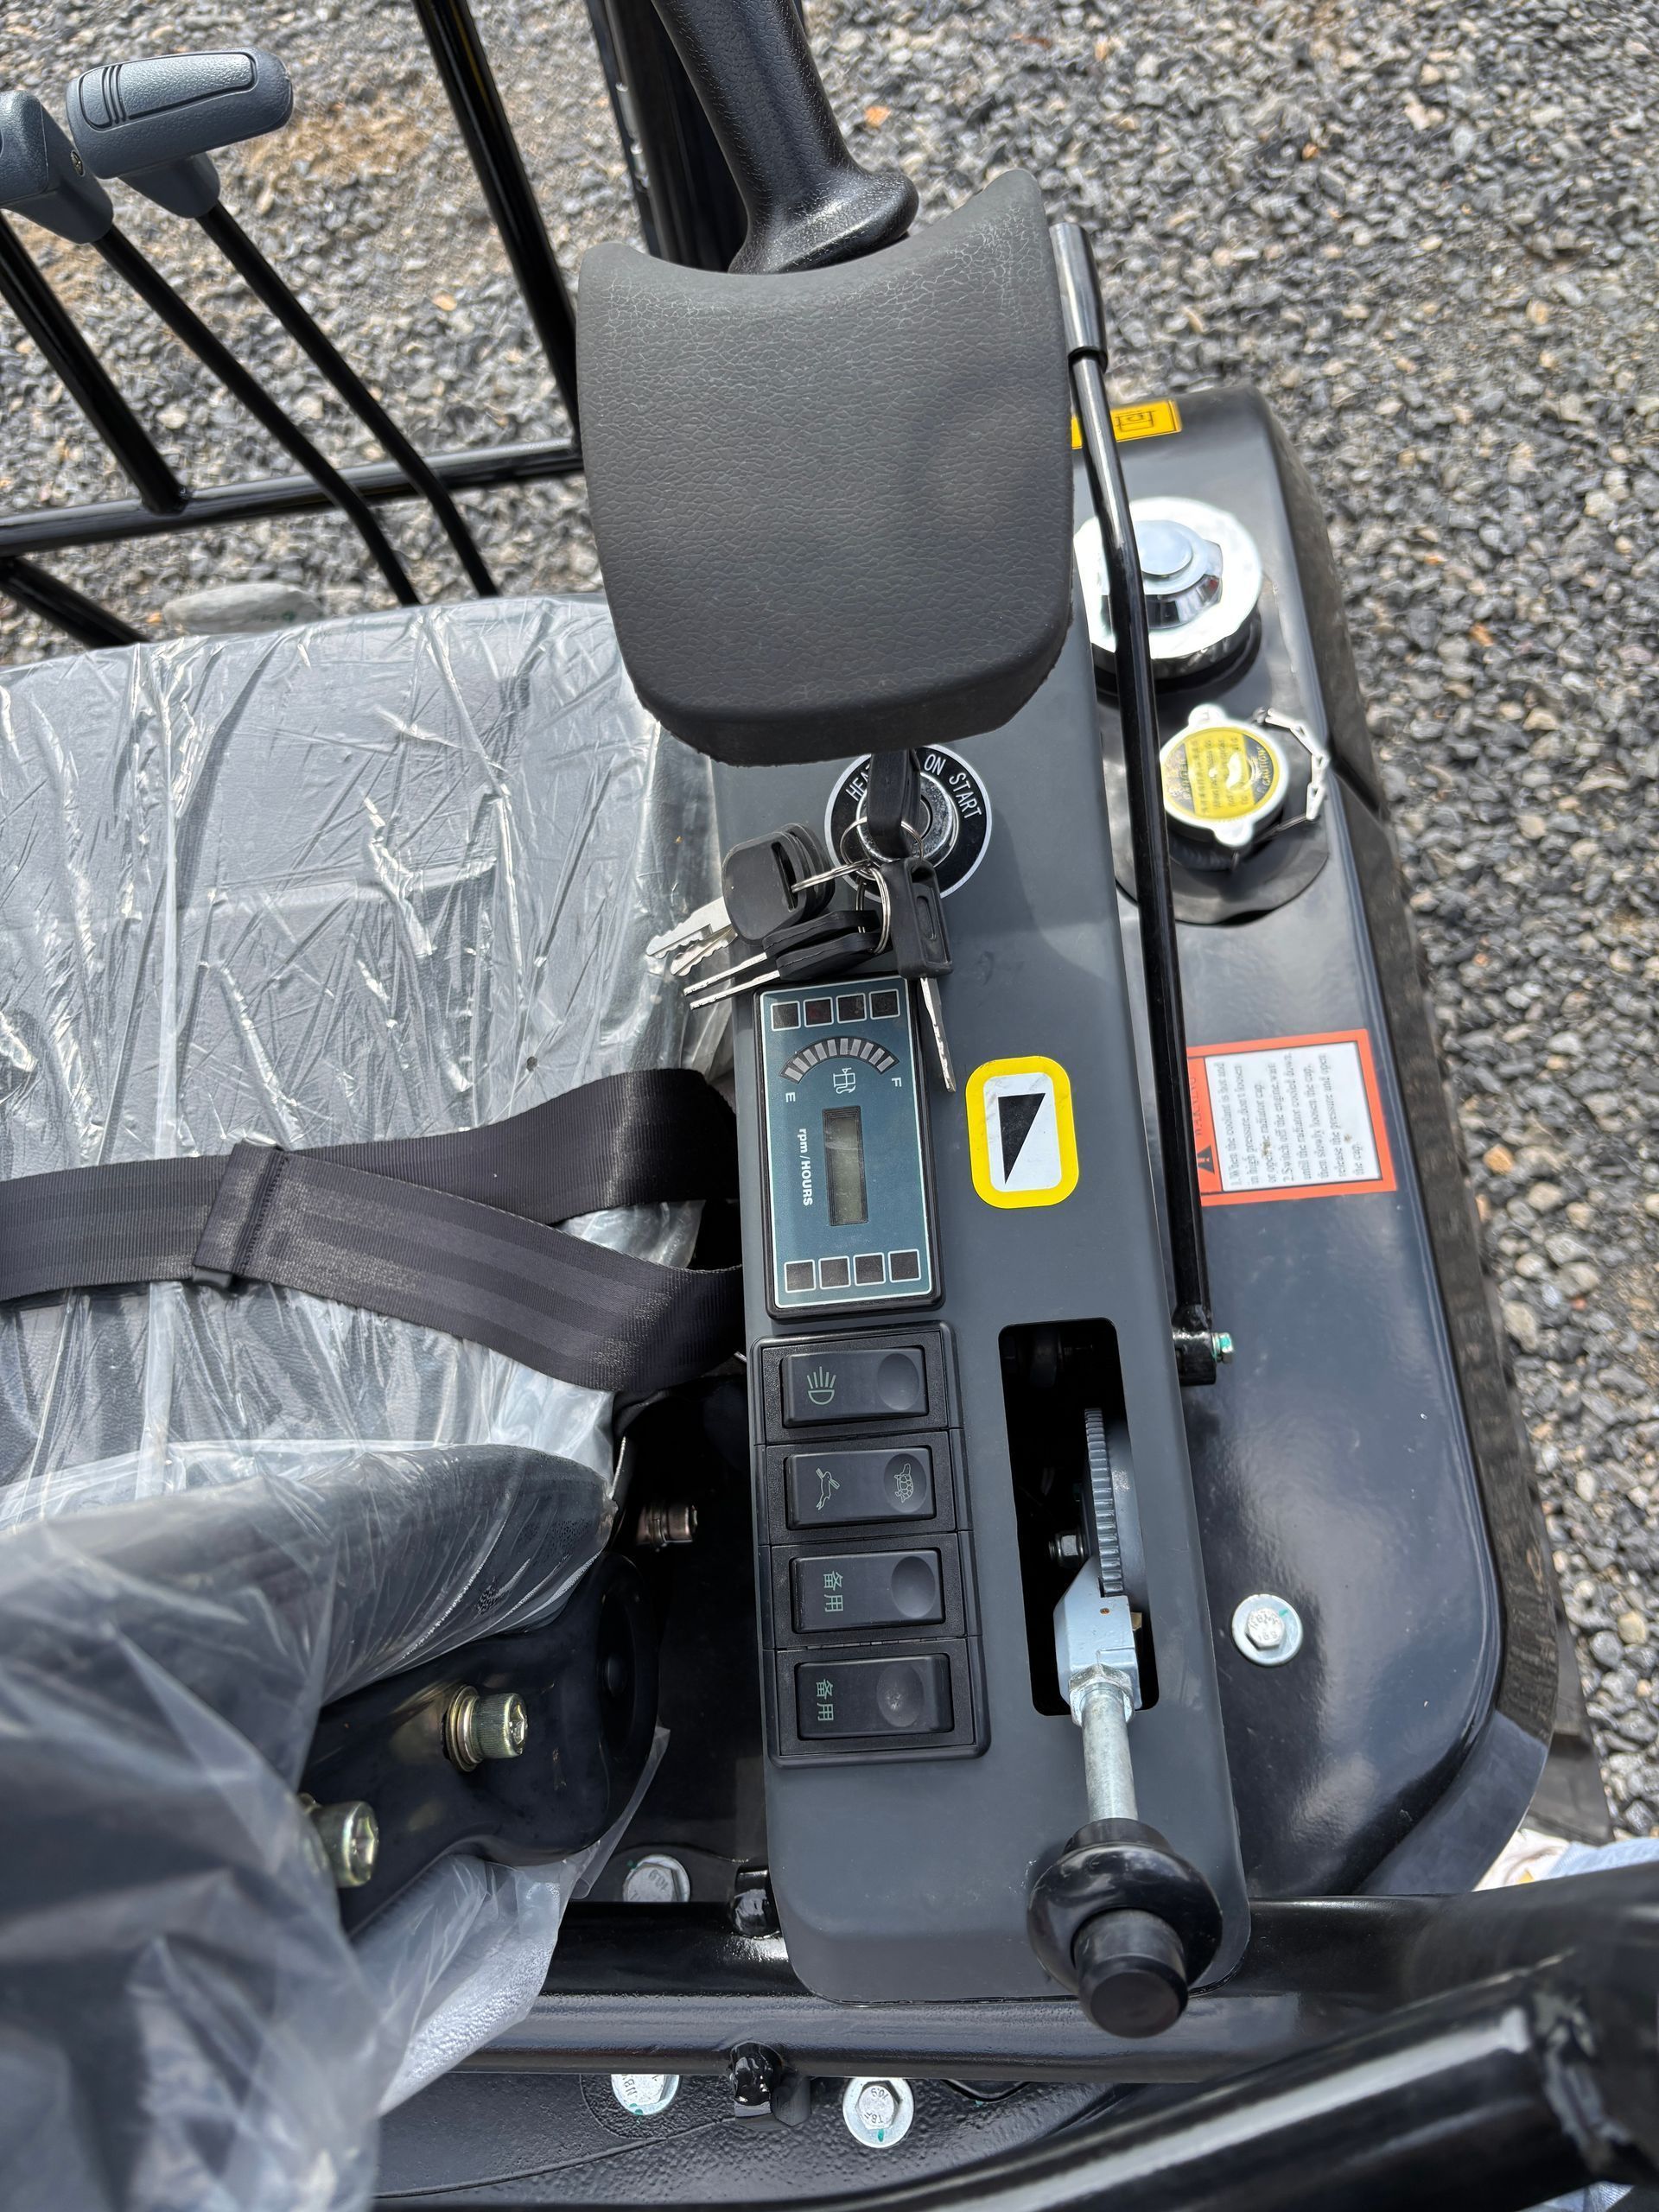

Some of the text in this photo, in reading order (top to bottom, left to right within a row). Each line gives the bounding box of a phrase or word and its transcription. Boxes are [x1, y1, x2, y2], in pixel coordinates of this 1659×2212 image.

[924, 753, 946, 776] ON
[949, 772, 982, 819] START
[1214, 1062, 1226, 1077] and
[1234, 1065, 1245, 1092] loosen
[891, 1077, 902, 1088] F
[1217, 1079, 1228, 1094] hot
[1304, 1084, 1316, 1097] the
[785, 1091, 796, 1103] E
[1284, 1079, 1300, 1108] cooled
[1222, 1104, 1234, 1135] coolant
[1255, 1100, 1268, 1134] radiator
[1274, 1114, 1286, 1128] the
[1308, 1099, 1320, 1128] loosen
[1318, 1054, 1346, 1177] release the pressure and open
[1292, 1109, 1306, 1142] radiator
[1225, 1137, 1236, 1152] the
[1274, 1129, 1287, 1142] off
[1311, 1129, 1326, 1158] slowly
[1296, 1144, 1308, 1159] the
[1243, 1155, 1260, 1174] high
[1317, 1160, 1329, 1179] then
[1352, 1162, 1364, 1176] the
[1268, 1174, 1277, 1183] or
[823, 1570, 844, 1612] 备用
[816, 1679, 834, 1721] 备用
